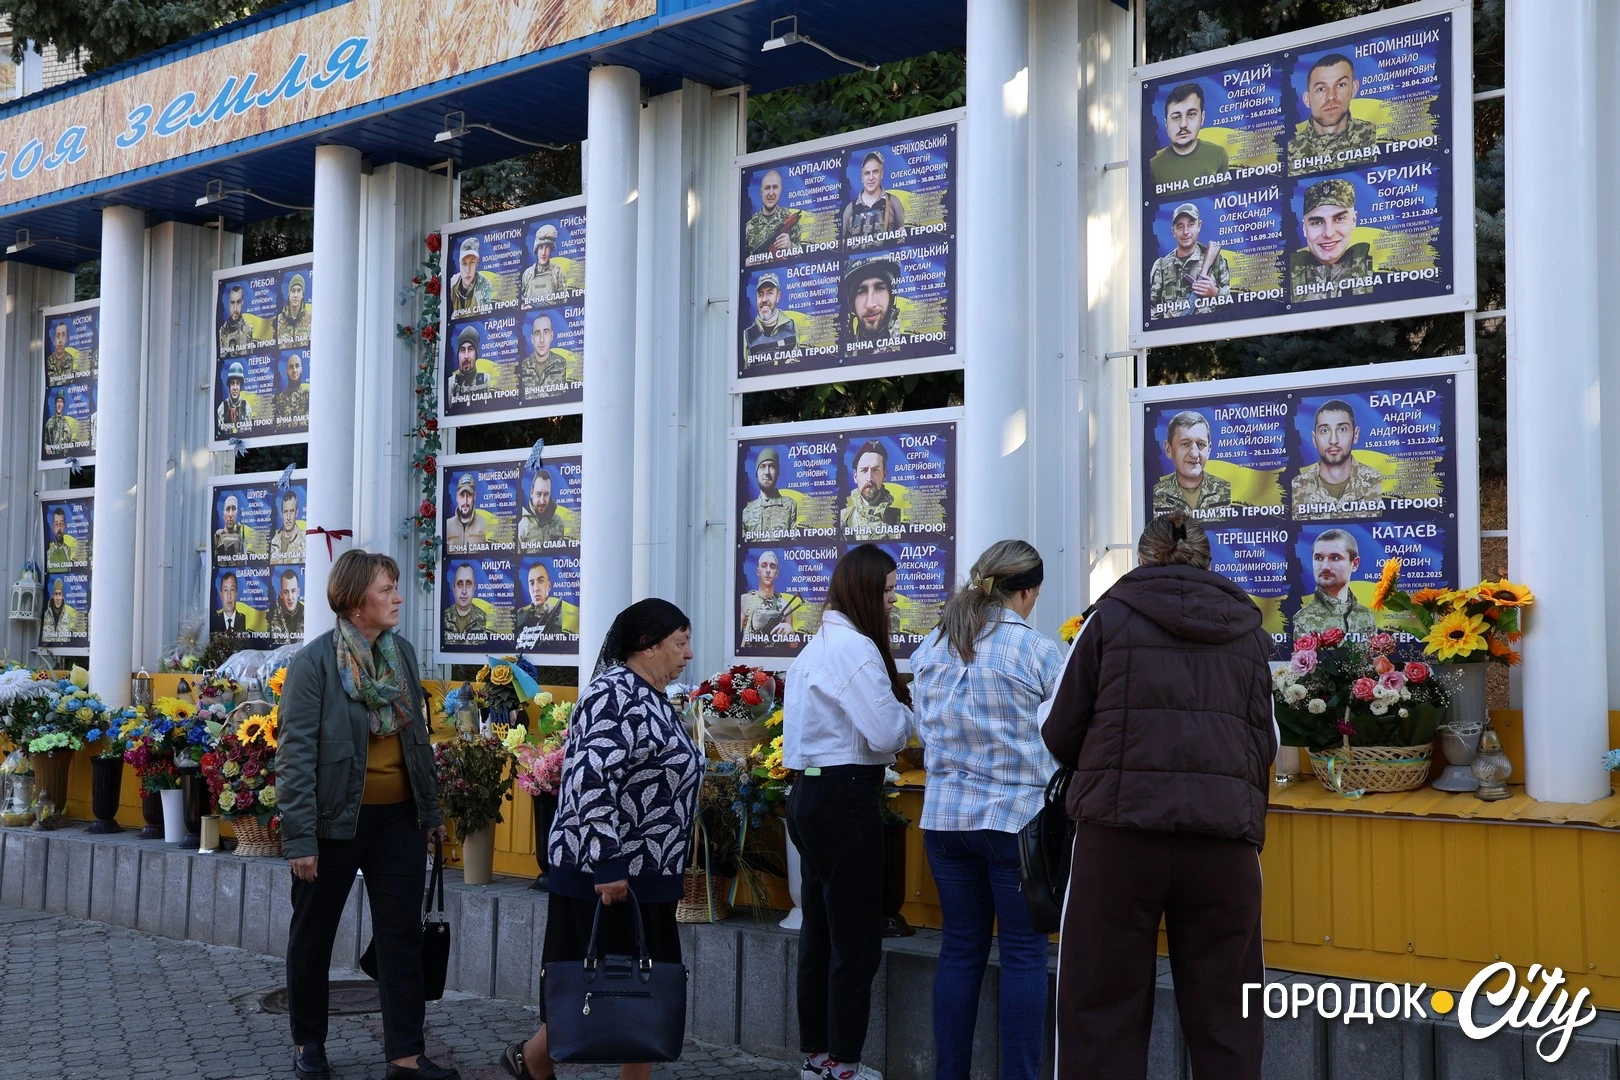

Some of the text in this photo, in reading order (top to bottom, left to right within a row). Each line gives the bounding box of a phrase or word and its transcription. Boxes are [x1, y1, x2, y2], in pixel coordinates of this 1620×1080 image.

[1355, 29, 1440, 58] НЕПОМНЯЩИХ
[1378, 53, 1419, 69] МИХАЙЛО
[1223, 64, 1272, 87] РУДИЙ
[1362, 62, 1435, 85] ВОЛОДИМИРОВИЧ
[116, 36, 371, 149] земля
[1227, 83, 1266, 99] ОЛЕКСІЙ
[1360, 75, 1437, 96] 07.02.1992 28.04.2024
[1218, 95, 1274, 114] СЕРГІЙОВИЧ
[1213, 107, 1282, 125] 22.03.1997 16.07.2024
[892, 134, 948, 155] ЧЕРНІХОВСЬКИЙ
[908, 153, 930, 164] СЕРГІЙ
[1294, 136, 1438, 169] ВІЧНА СЛАВА ГЕРОЮ!
[789, 158, 841, 176] КАРПАЛЮК
[891, 162, 948, 179] ОЛЕКСАНДРОВИЧ
[1367, 163, 1432, 185] БУРЛИК
[805, 176, 825, 185] ВІКТОР
[1155, 163, 1282, 194] ВІЧНА СЛАВА ГЕРОЮ!
[788, 183, 841, 199] ВОЛОДИМИРОВИЧ
[1214, 185, 1279, 210] МОЦНИЙ
[1378, 184, 1418, 197] БОГДАН
[1371, 195, 1425, 211] ПЕТРОВИЧ
[1220, 207, 1273, 223] ОЛЕКСАНДР
[1359, 208, 1438, 224] 23.10.1993 23.11.2024
[847, 223, 947, 247] ВІЧНА СЛАВА ГЕРОЮ!
[1219, 219, 1276, 236] ВІКТОРОВИЧ
[484, 229, 521, 243] МИКИТЮК
[1213, 231, 1282, 247] 04.01.1983 16.09.2024
[749, 240, 839, 263] ВІЧНА СЛАВА ГЕРОЮ!
[889, 242, 948, 262] ПАВЛУЦЬКИЙ
[787, 261, 839, 278] ВАСЕРМАН
[904, 262, 931, 272] РУСЛАН
[891, 271, 946, 285] АНАТОЛІЙОВИЧ
[1296, 267, 1439, 295] ВІЧНА СЛАВА ГЕРОЮ!
[524, 290, 570, 305] ВІЧНА СЛАВА
[1157, 287, 1284, 313] ВІЧНА СЛАВА ГЕРОЮ!
[453, 299, 519, 317] ВІЧНА СЛАВА ГЕРОЮ!
[565, 307, 584, 318] БІЛИ
[485, 318, 515, 330] ГАРДИШ
[847, 332, 946, 352] ВІЧНА СЛАВА ГЕРОЮ!
[747, 345, 839, 364] ВІЧНА СЛАВА ГЕРОЮ!
[525, 383, 568, 394] ВІЧНА СЛАВА
[452, 389, 519, 404] ВІЧНА СЛАВА ГЕРОЮ!
[1369, 390, 1436, 408] БАРДАР
[1214, 403, 1288, 421] ПАРХОМЕНКО
[1383, 410, 1422, 423] АНДРІЙ
[1220, 422, 1280, 436] ВОЛОДИМИР
[1369, 421, 1436, 437] АНДРІЙОВИЧ
[900, 435, 936, 448] ТОКАР
[1217, 433, 1282, 448] МИХАЙЛОВИЧ
[1364, 436, 1444, 449] 15.03.1996 13.12.2024
[788, 443, 837, 459] ДУБОВКА
[907, 450, 929, 460] СЕРГІЙ
[1216, 448, 1287, 459] 20.05.1971 26.11.2024
[560, 465, 582, 475] ГОРВ
[794, 459, 831, 468] ВОЛОДИМИР
[895, 462, 941, 471] ВАЛЕРІЙОВИЧ
[478, 468, 520, 481] ВИШНЕВСЬКИЙ
[796, 469, 828, 478] ЮРІЙОВИЧ
[1242, 505, 1285, 517] ГЕРОЮ!
[1298, 497, 1443, 514] ВІЧНА СЛАВА ГЕРОЮ!
[746, 527, 836, 540] ВІЧНА СЛАВА ГЕРОЮ!
[845, 523, 946, 536] ВІЧНА СЛАВА ГЕРОЮ!
[1372, 524, 1437, 539] КАТАЄВ
[521, 541, 541, 549] ВІЧНА
[1216, 530, 1288, 546] ТЕРЕЩЕНКО
[449, 544, 467, 552] ВІЧНА
[491, 542, 515, 550] ГЕРОЮ!
[784, 546, 838, 560] КОСОВСЬКИЙ
[900, 546, 936, 560] ДІДУР
[1234, 548, 1265, 559] ВІТАЛІЙ
[1384, 544, 1422, 555] ВАДИМ
[482, 561, 510, 572] КИЦУТА
[553, 559, 580, 568] ПОЛЬО
[798, 563, 823, 572] ВІТАЛІЙ
[897, 561, 939, 570] ОЛЕКСАНДР
[1214, 561, 1288, 573] ВОЛОДИМИРОВИЧ
[1376, 556, 1431, 567] ЮЙОВИЧ
[745, 634, 769, 643] ВІЧНА
[772, 634, 800, 642] СЛАВА
